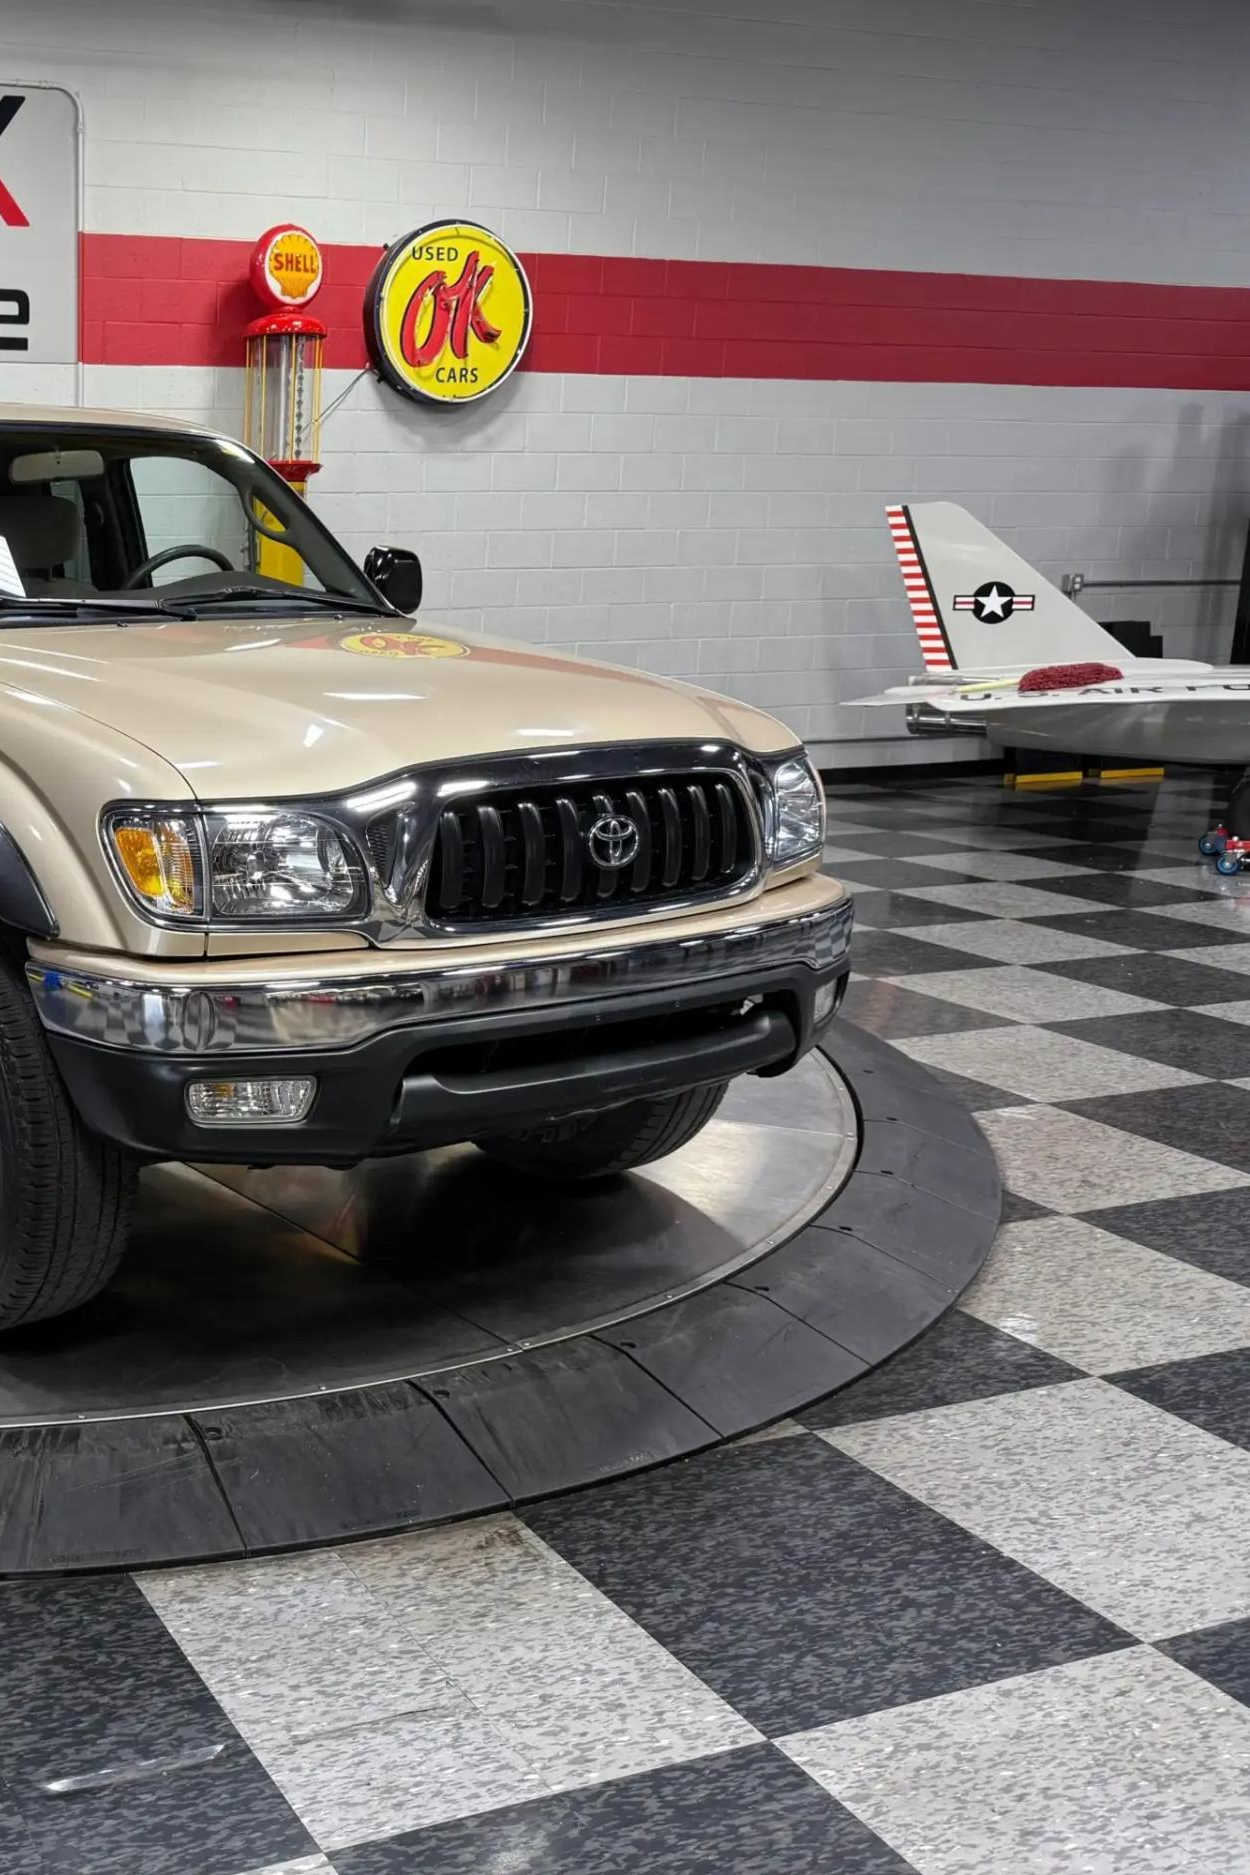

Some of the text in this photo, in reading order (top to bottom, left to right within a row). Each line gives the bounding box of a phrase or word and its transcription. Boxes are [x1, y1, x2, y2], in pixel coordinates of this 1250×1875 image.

[273, 252, 317, 275] SHELL
[411, 246, 459, 262] USED
[400, 250, 502, 368] OK
[435, 367, 479, 384] CARS
